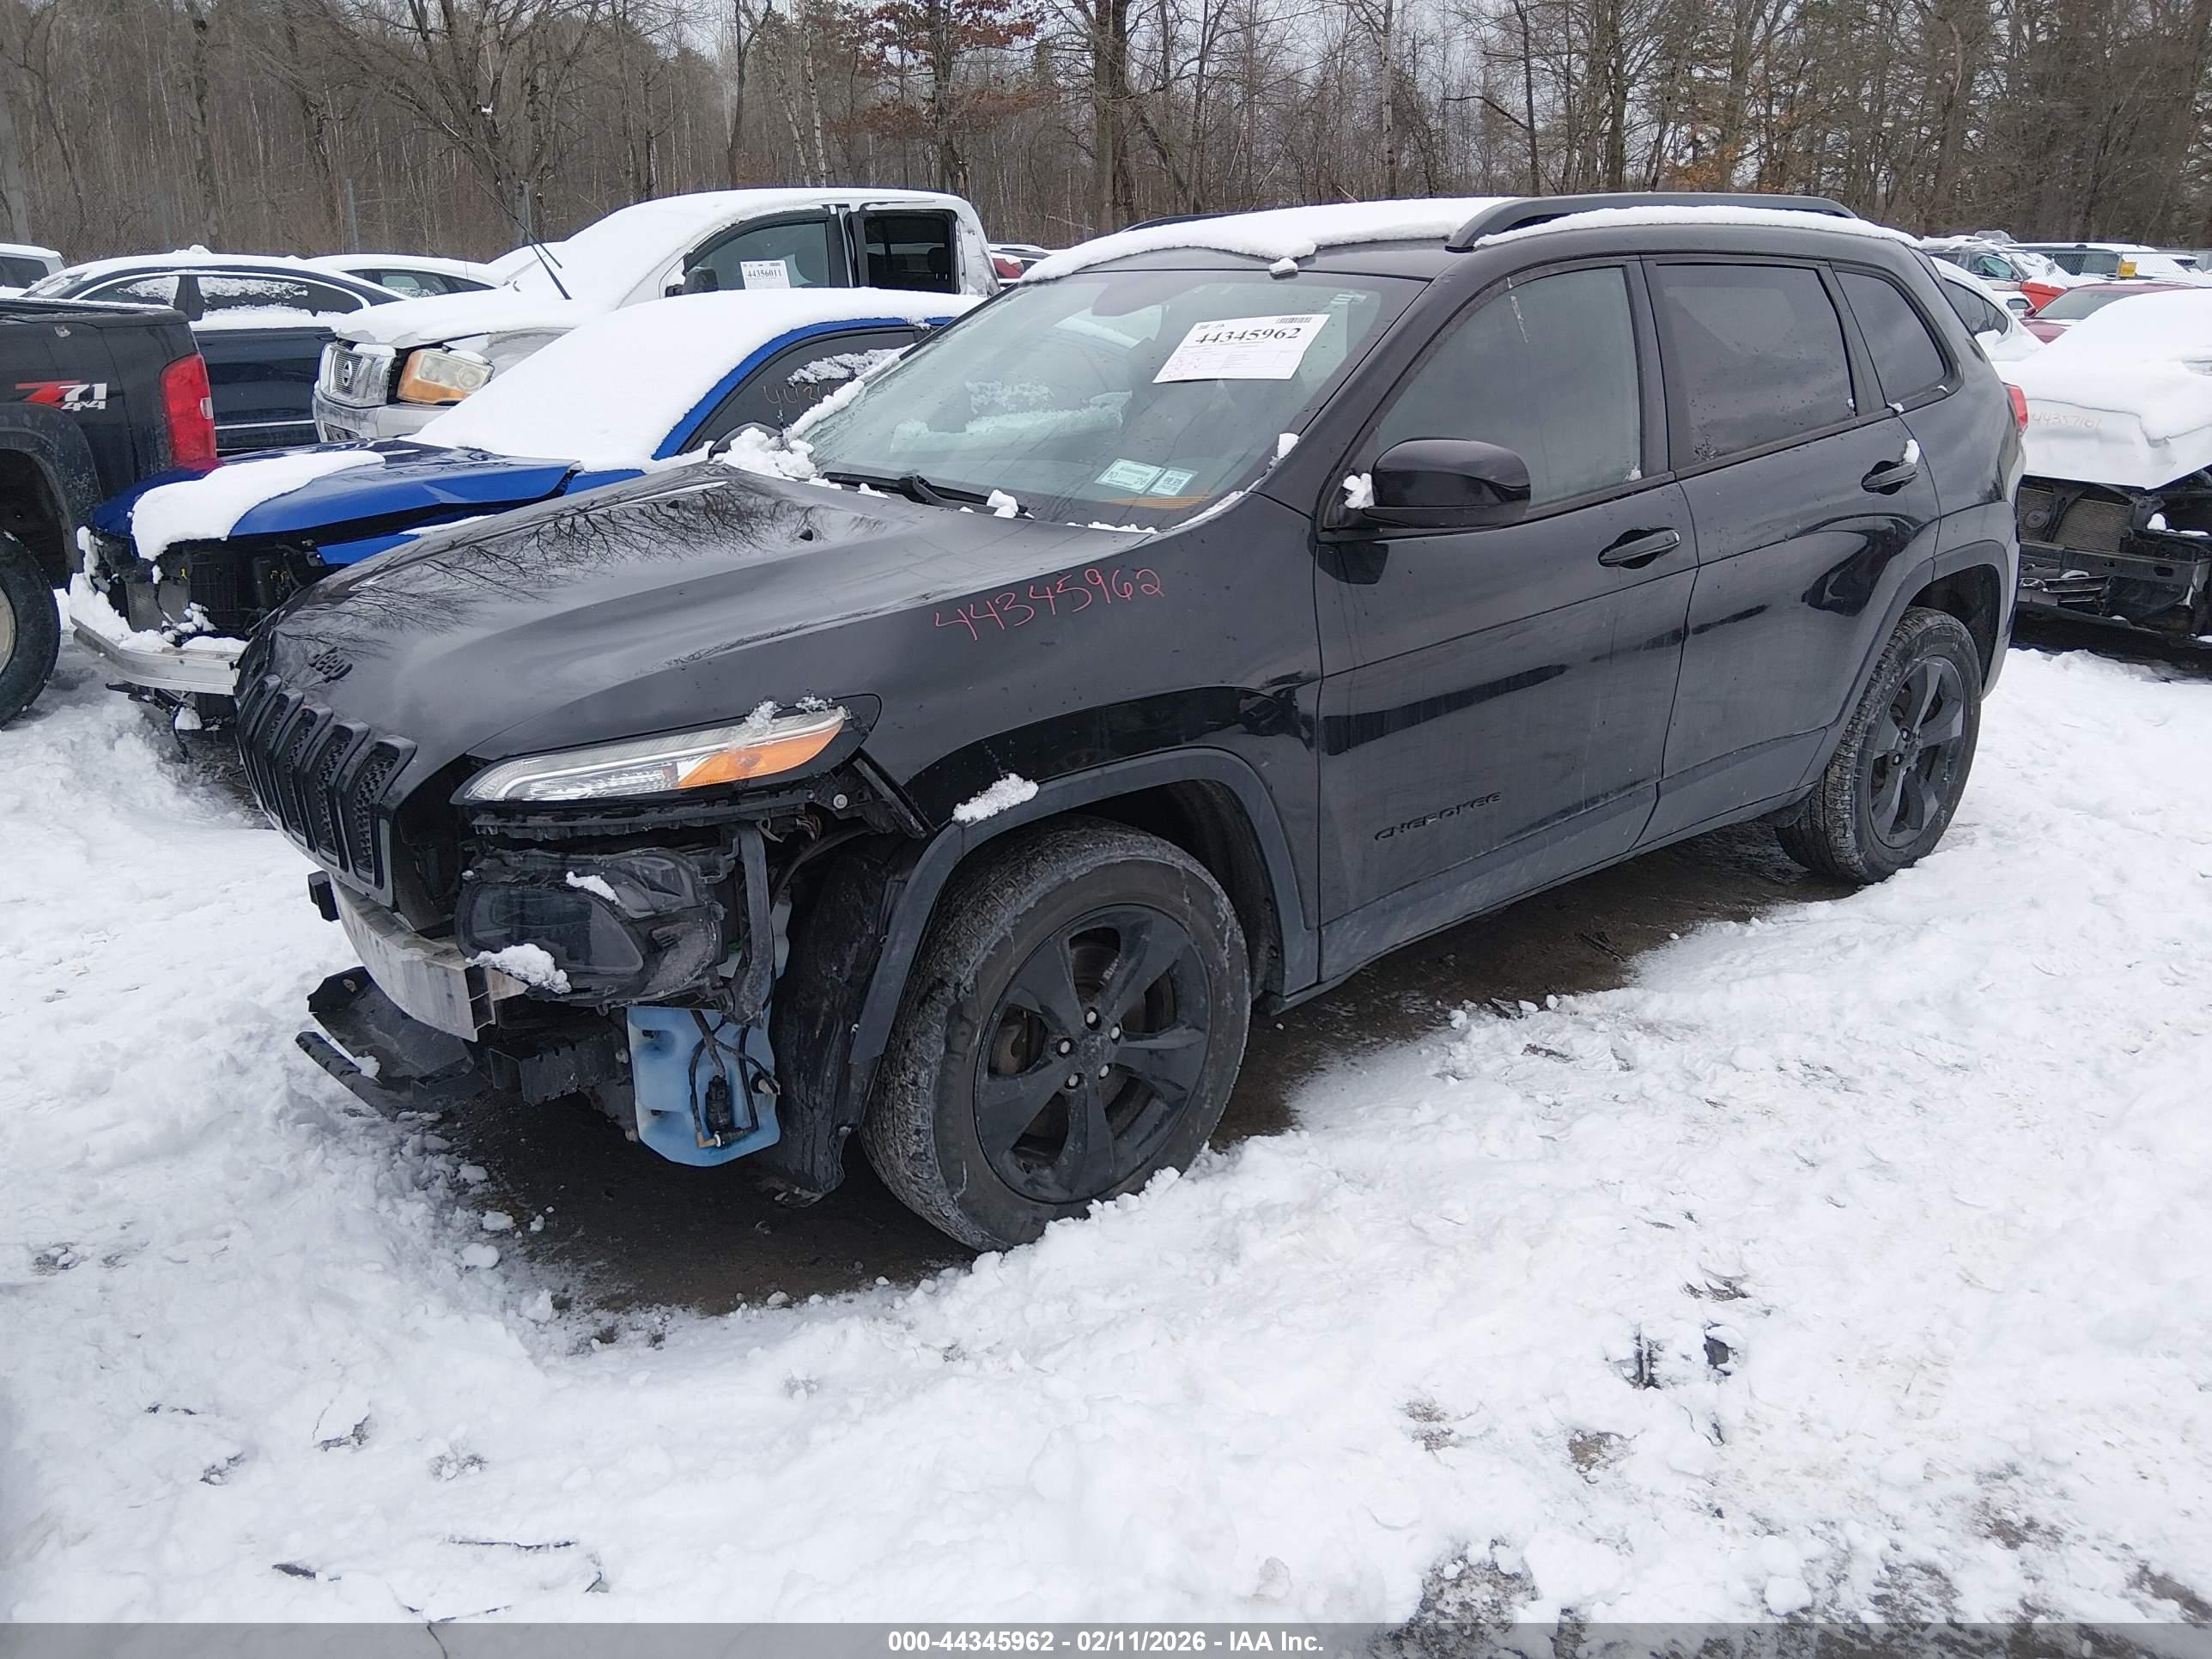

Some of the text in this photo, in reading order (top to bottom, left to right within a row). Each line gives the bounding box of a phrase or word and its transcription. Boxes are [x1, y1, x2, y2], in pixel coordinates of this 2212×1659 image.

[747, 269, 782, 278] 44356011
[1195, 327, 1302, 344] 44345962
[15, 380, 107, 408] Z71
[60, 400, 106, 411] 4x4
[934, 568, 1165, 641] 44345962
[308, 647, 353, 684] Jeep
[1374, 791, 1502, 842] CHEROKEE
